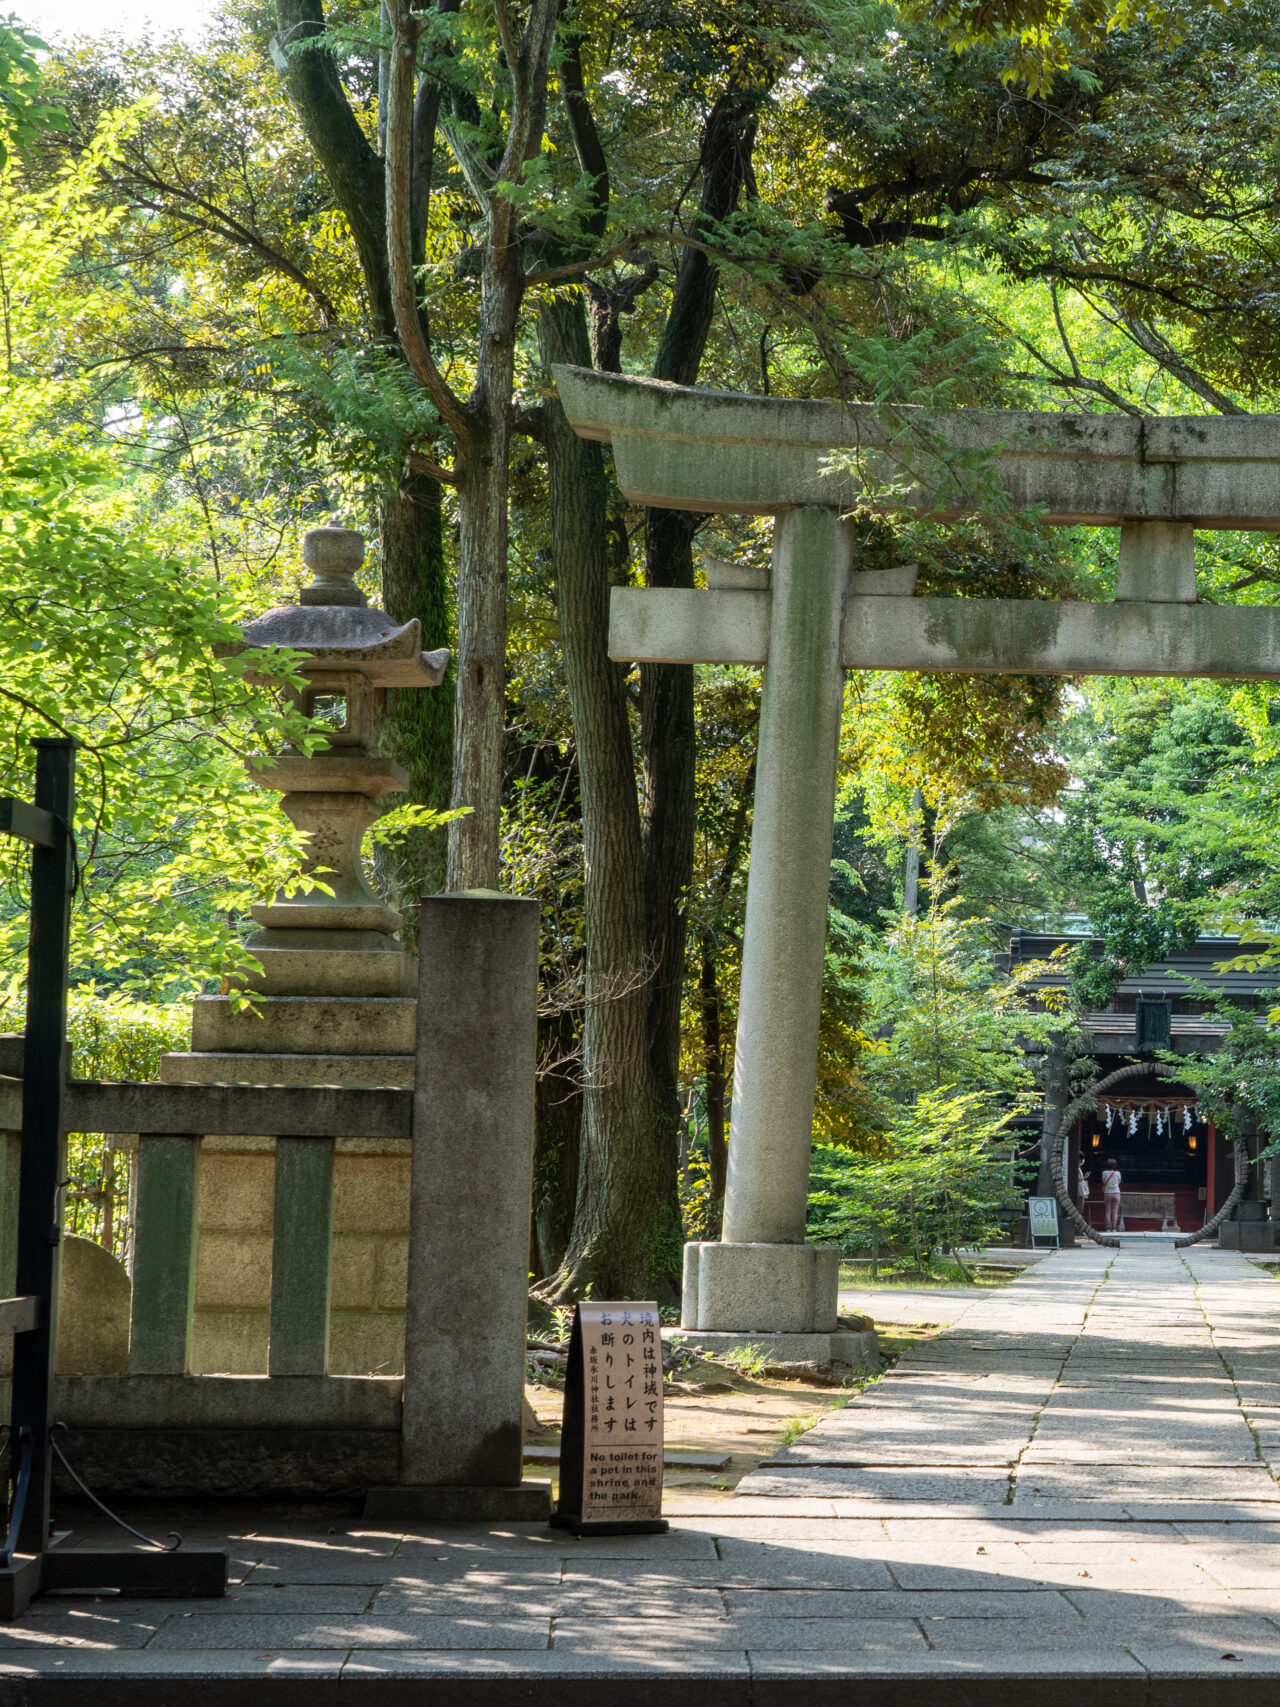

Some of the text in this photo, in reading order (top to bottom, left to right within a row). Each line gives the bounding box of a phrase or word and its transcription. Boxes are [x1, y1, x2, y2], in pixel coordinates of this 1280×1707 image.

[601, 1312, 617, 1433] お断りします
[621, 1311, 637, 1432] 犬のトイレは
[640, 1311, 658, 1432] 境内は神域です
[590, 1452, 657, 1461] No toilet for
[601, 1466, 619, 1476] pet
[622, 1465, 633, 1474] in
[636, 1464, 657, 1473] this
[590, 1478, 656, 1487] shrine and
[590, 1491, 608, 1500] the
